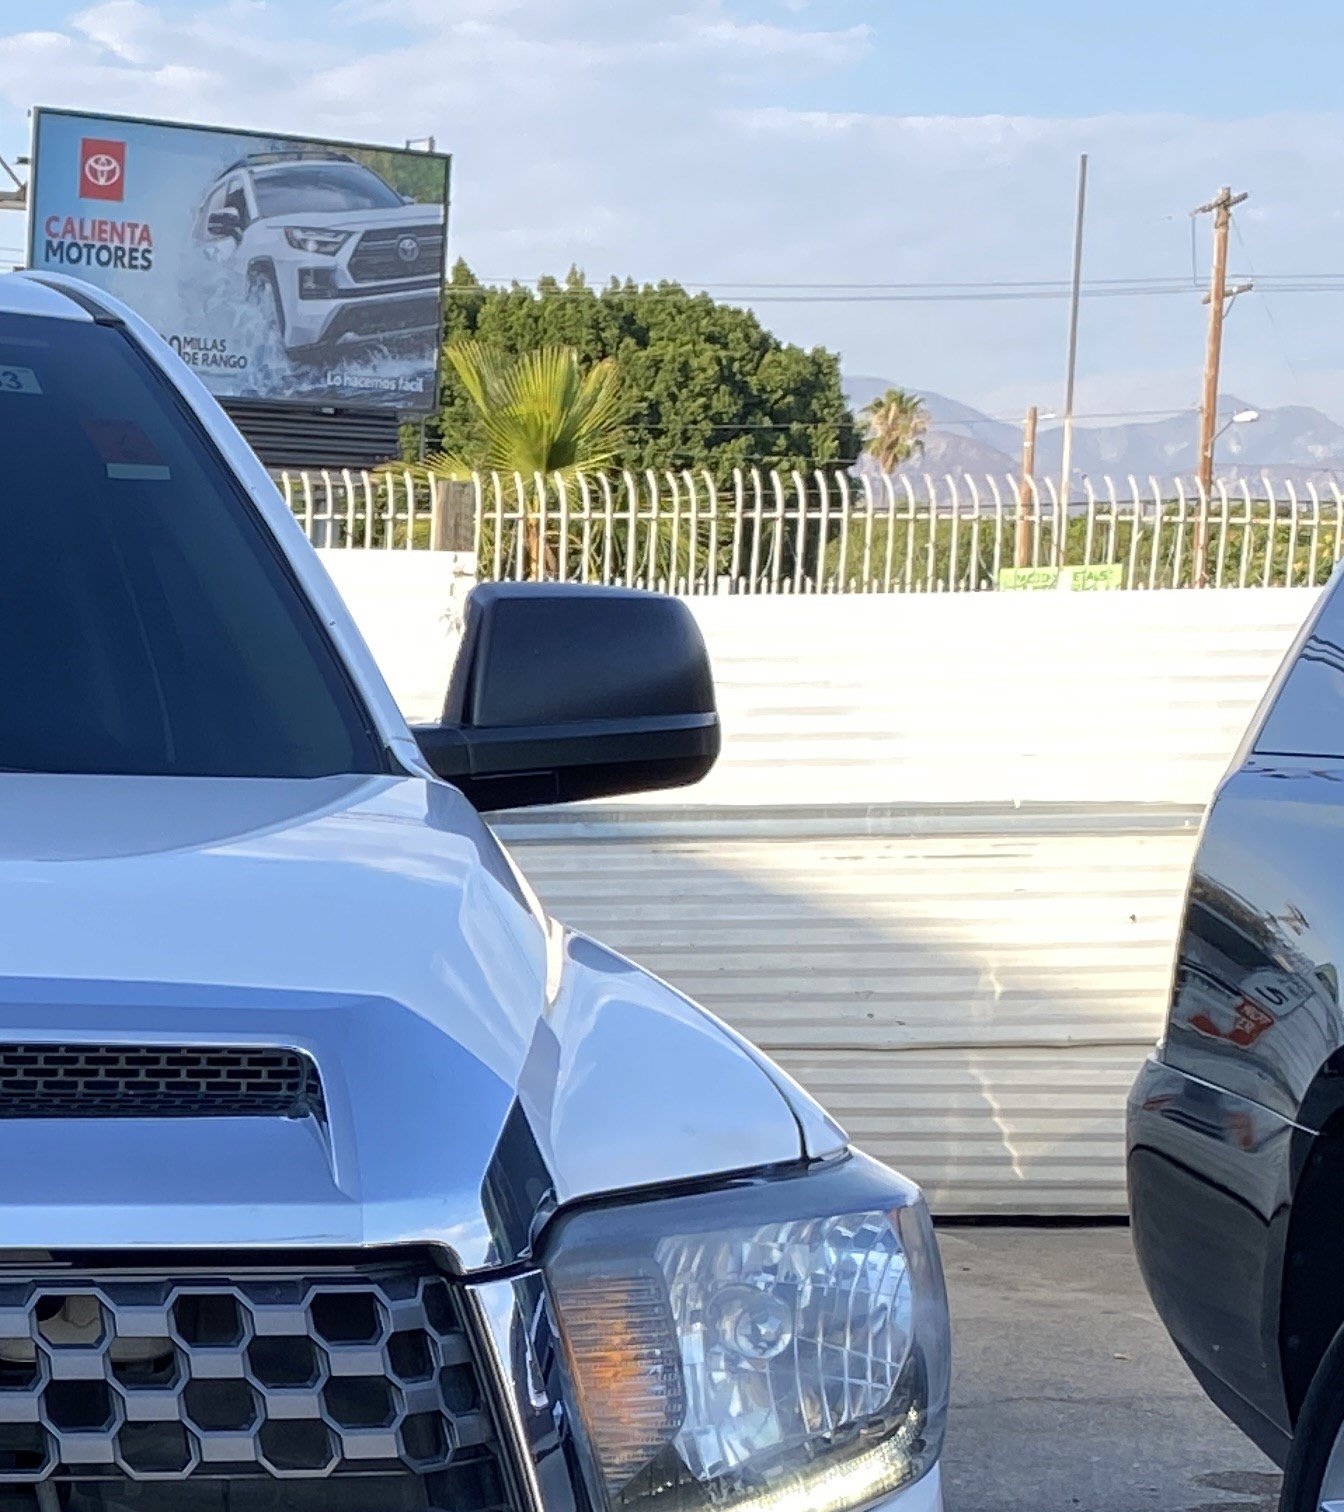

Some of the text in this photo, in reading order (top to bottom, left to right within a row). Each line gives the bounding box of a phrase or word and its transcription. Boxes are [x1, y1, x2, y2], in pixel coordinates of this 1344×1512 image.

[45, 215, 153, 247] CALIENTA
[44, 239, 153, 271] MOTORES
[183, 336, 226, 352] MILLAS
[183, 351, 248, 370] DE RANGO
